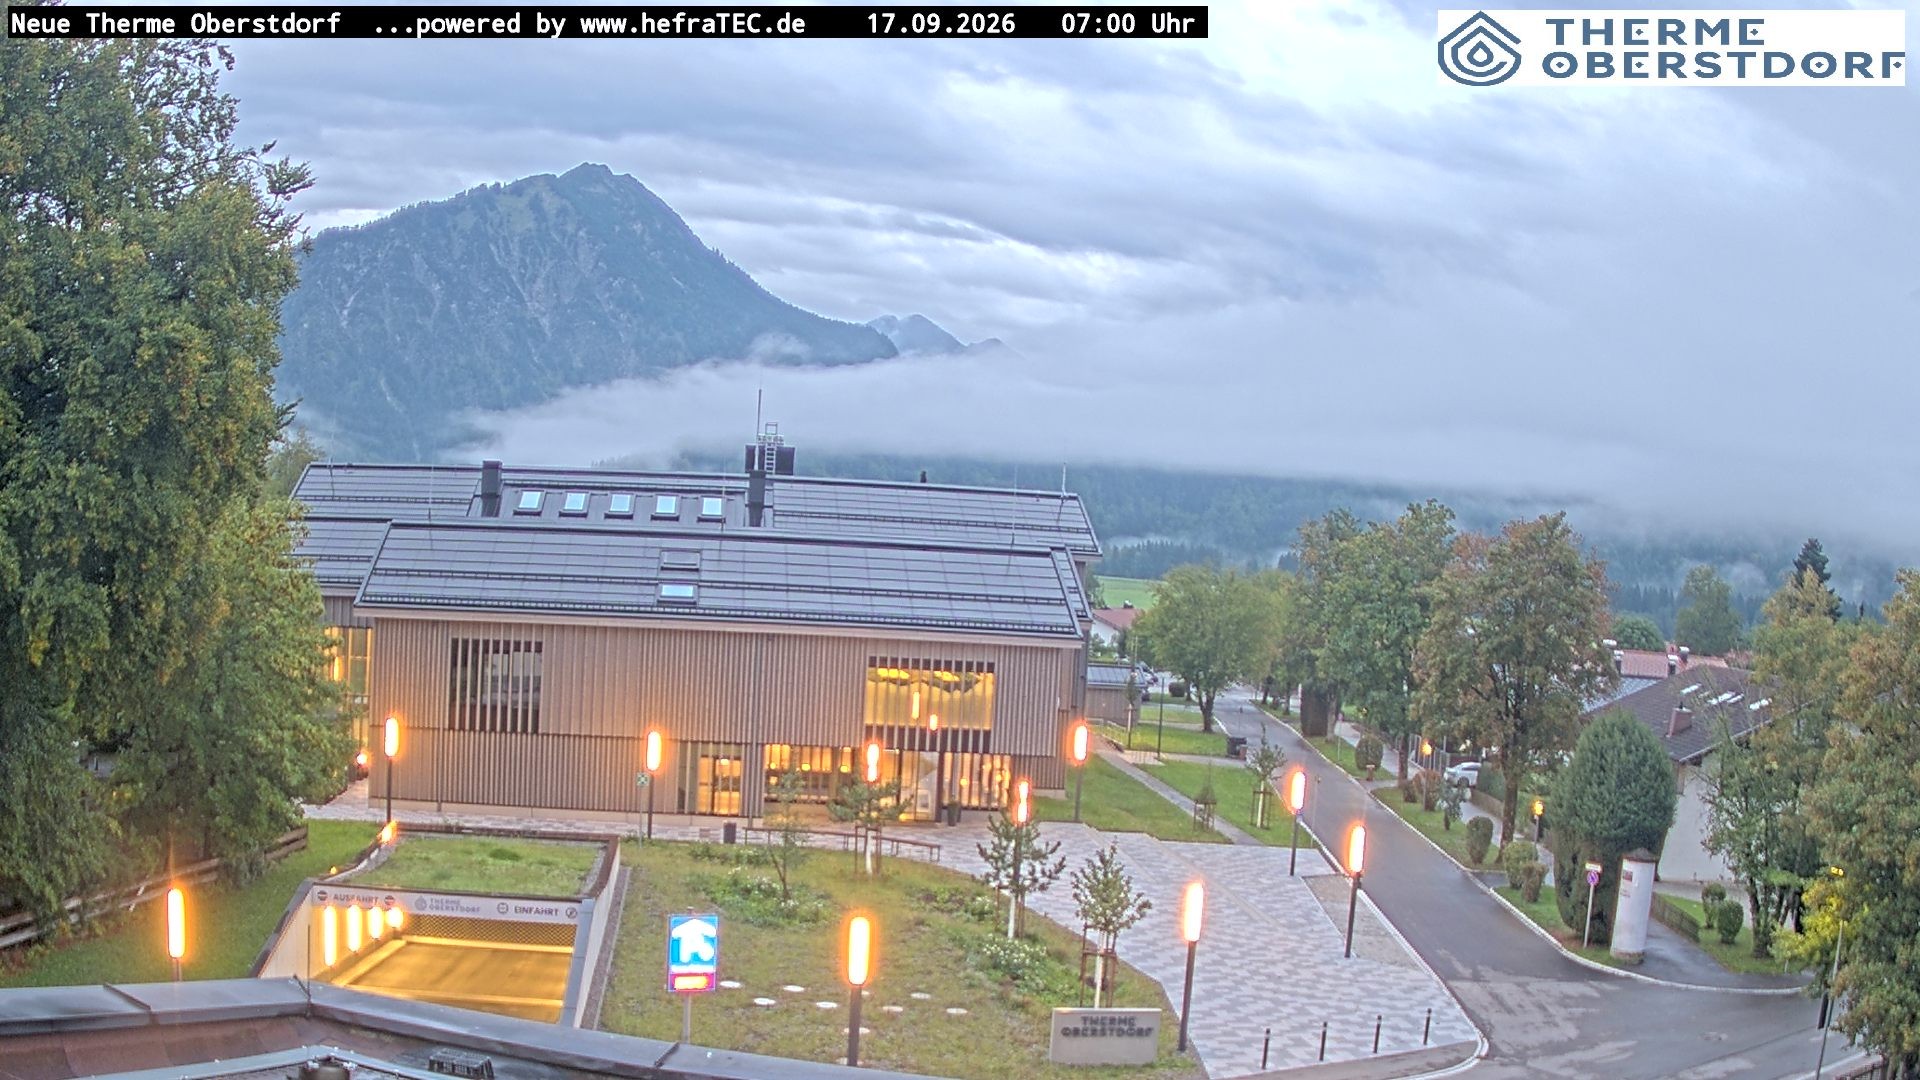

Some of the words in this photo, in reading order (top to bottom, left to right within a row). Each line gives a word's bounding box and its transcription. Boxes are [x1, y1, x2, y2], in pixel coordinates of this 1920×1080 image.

[333, 893, 379, 904] AUSFAHRT
[514, 905, 560, 917] EINFAHRT
[1080, 1015, 1137, 1027] THERME
[1060, 1026, 1154, 1037] OBERSTDORF
